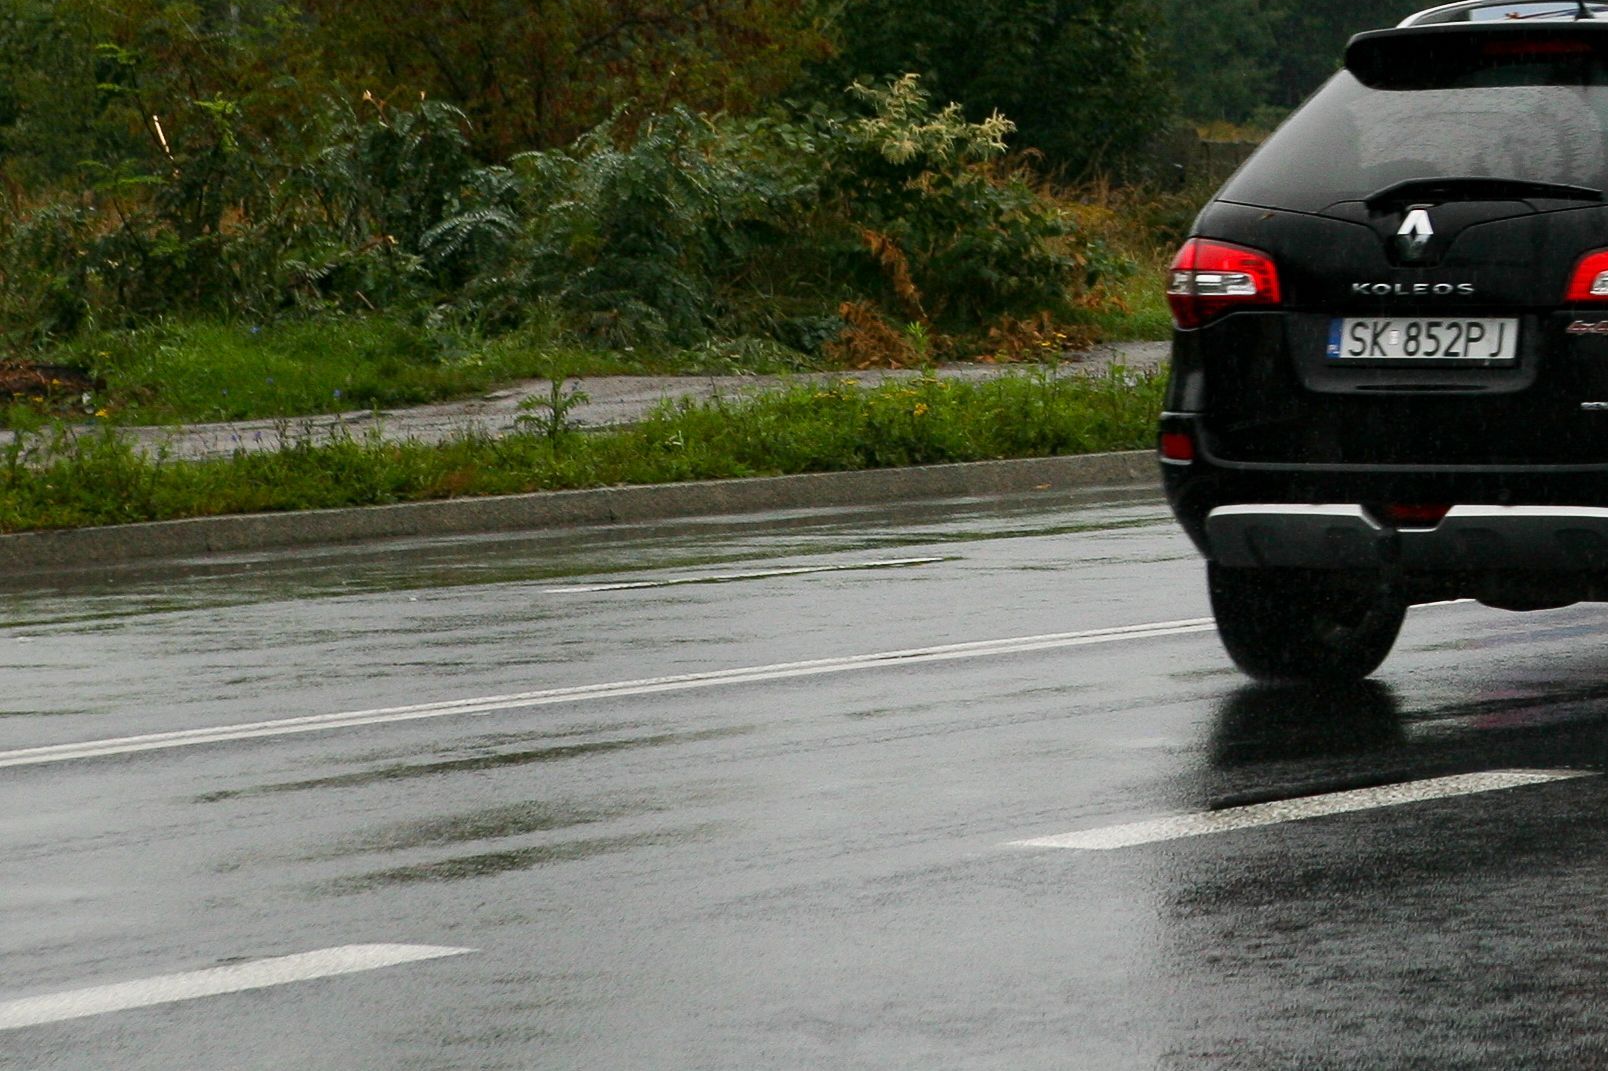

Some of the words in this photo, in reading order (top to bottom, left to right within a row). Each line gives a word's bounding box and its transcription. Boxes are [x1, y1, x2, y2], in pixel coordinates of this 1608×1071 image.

[1352, 282, 1476, 296] KOLEOS
[1348, 321, 1392, 358] SK
[1403, 320, 1505, 359] 852PJ
